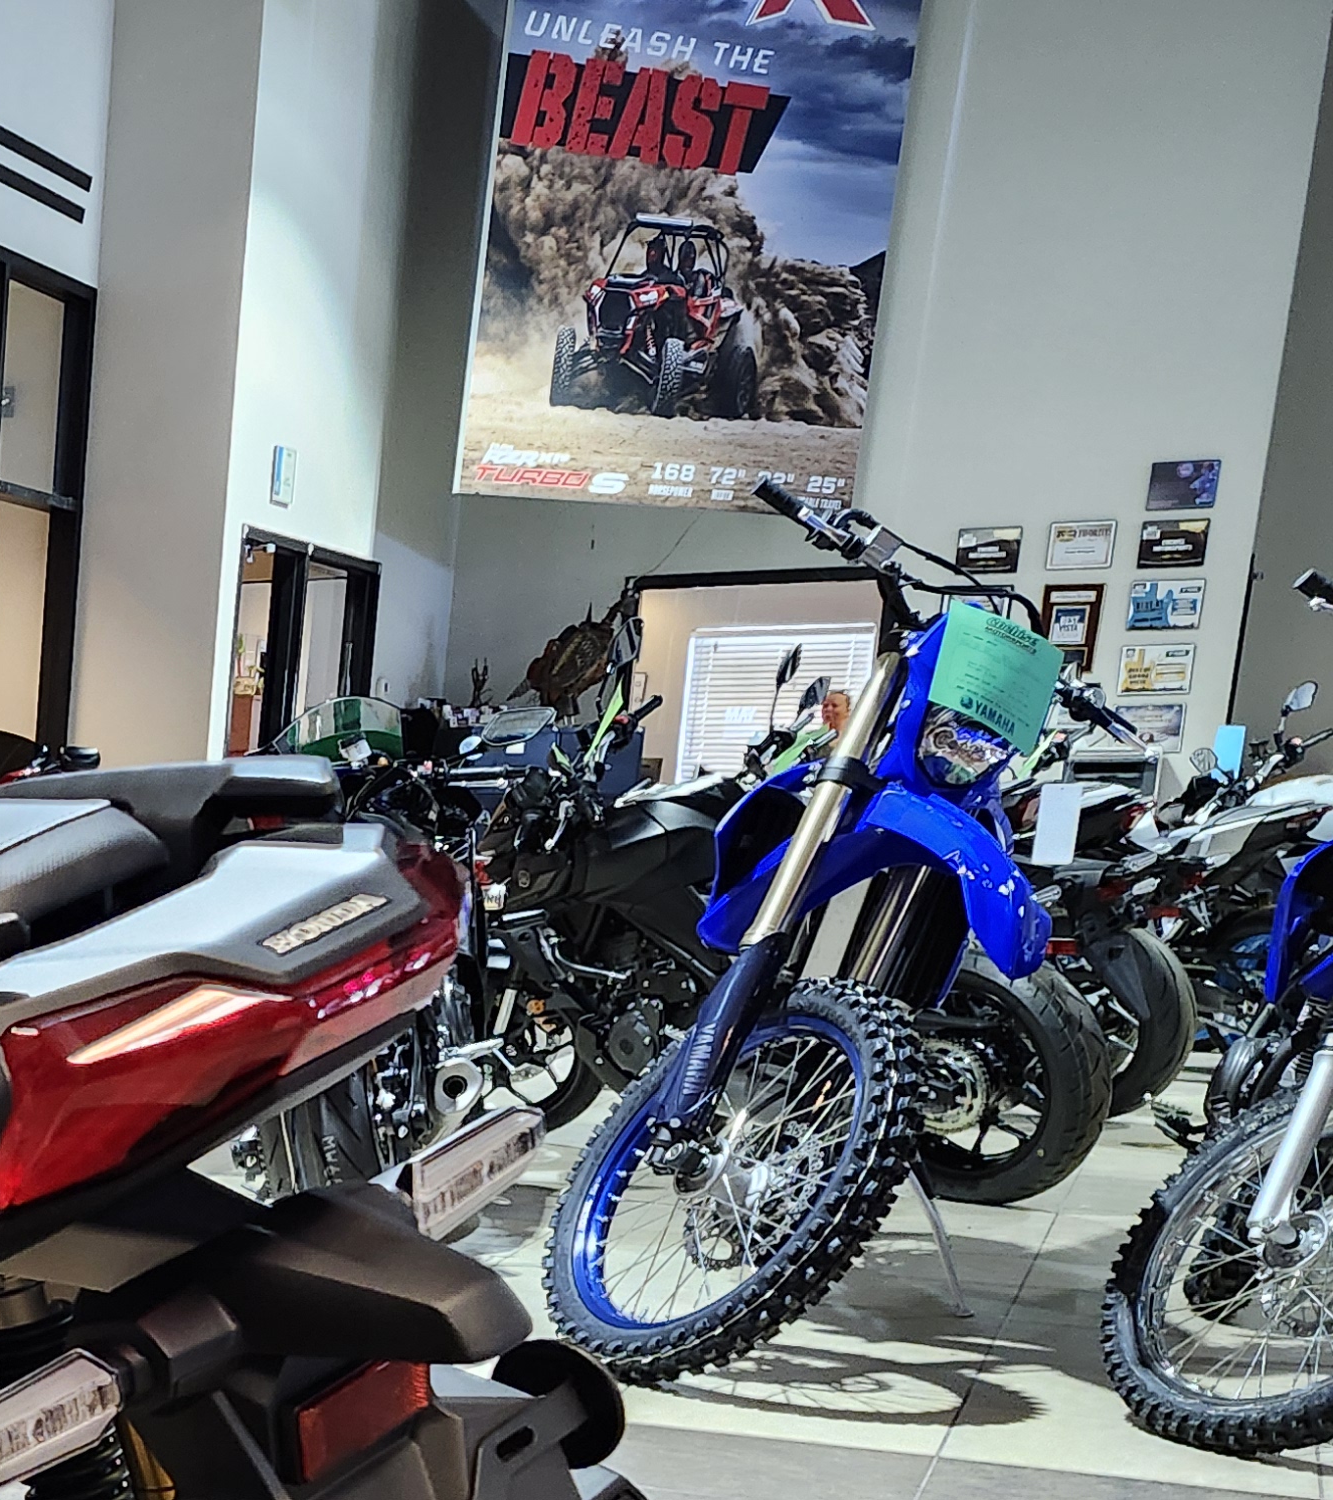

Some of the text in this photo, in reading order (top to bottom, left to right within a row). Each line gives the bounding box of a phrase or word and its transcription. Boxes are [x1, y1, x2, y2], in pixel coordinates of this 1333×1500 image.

[523, 10, 696, 62] UNLEASH
[712, 40, 776, 75] THE
[510, 49, 771, 175] BEAST
[475, 465, 630, 494] TURBO S
[651, 462, 696, 482] 168
[710, 466, 747, 485] 72"
[806, 475, 846, 494] 25"
[974, 700, 1016, 737] YAMAHA
[682, 1022, 717, 1095] YAMAHA
